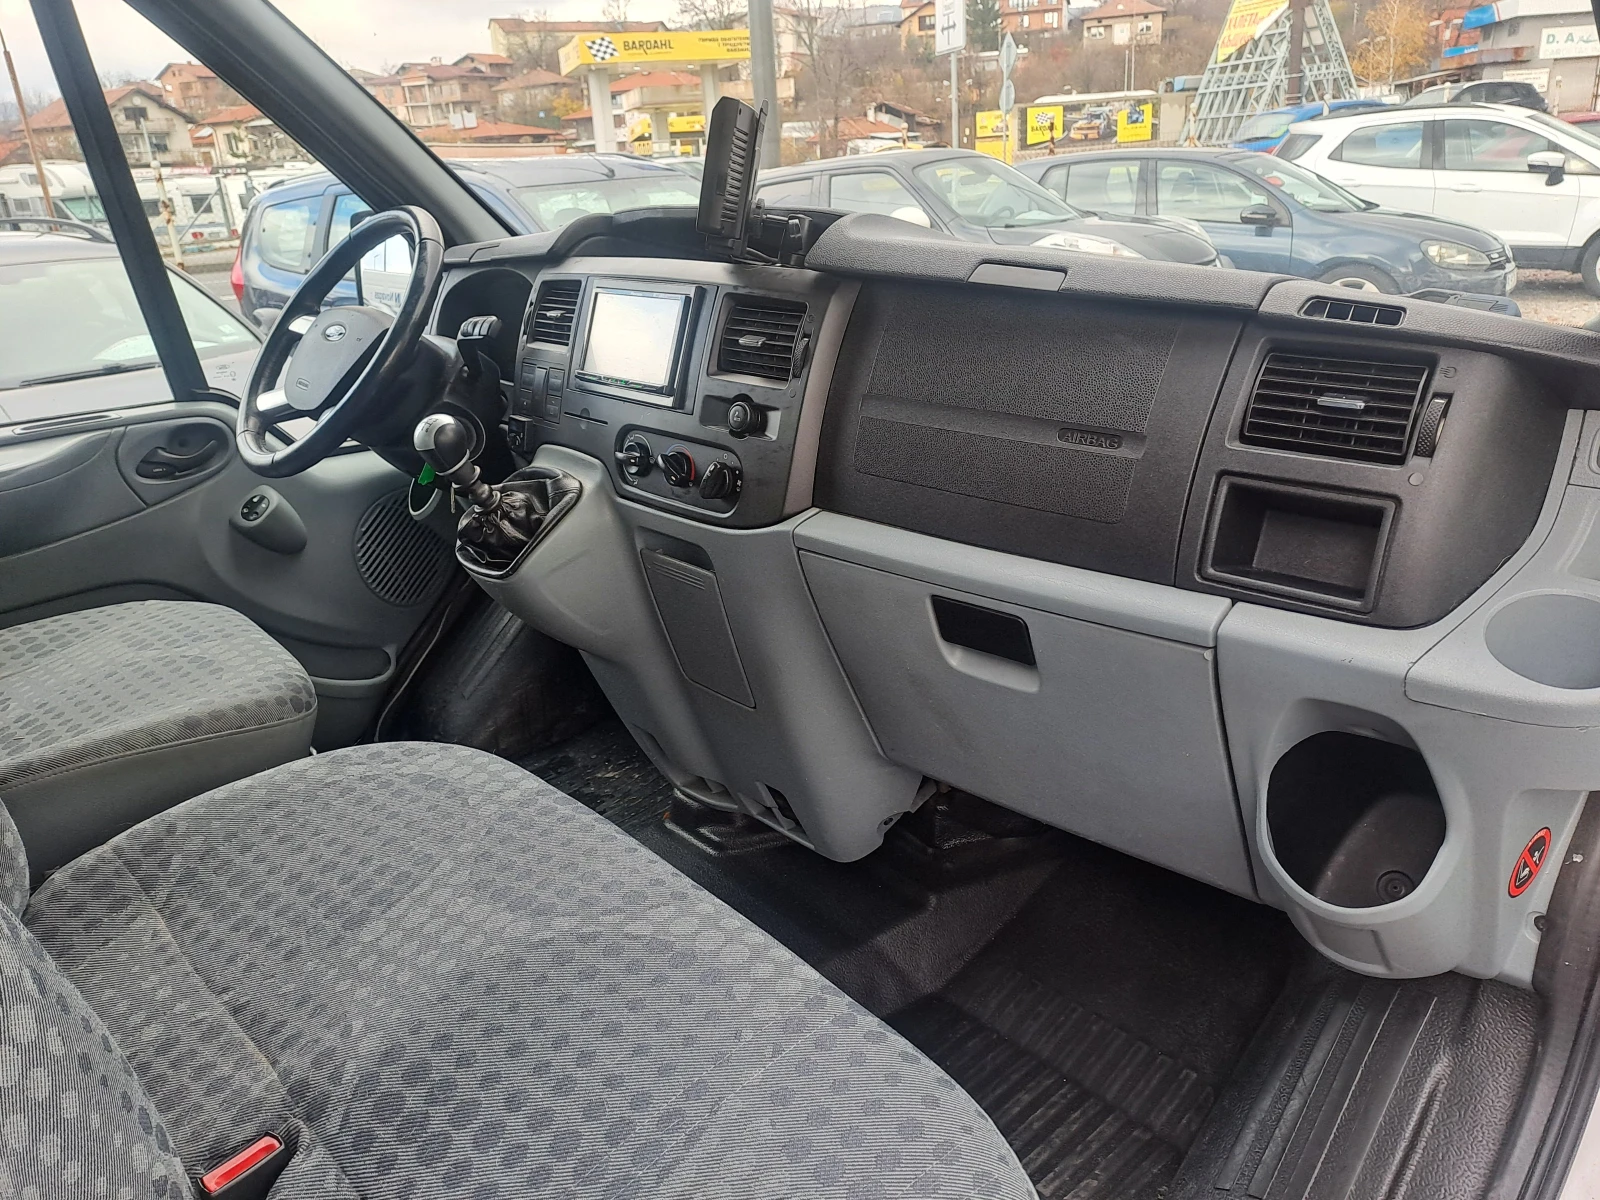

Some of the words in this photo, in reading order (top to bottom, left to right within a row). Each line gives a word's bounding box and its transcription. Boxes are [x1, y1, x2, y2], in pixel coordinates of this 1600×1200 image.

[623, 39, 675, 55] BARDAHL
[1030, 125, 1059, 136] BARDAL
[1063, 431, 1119, 449] AIRBAG
